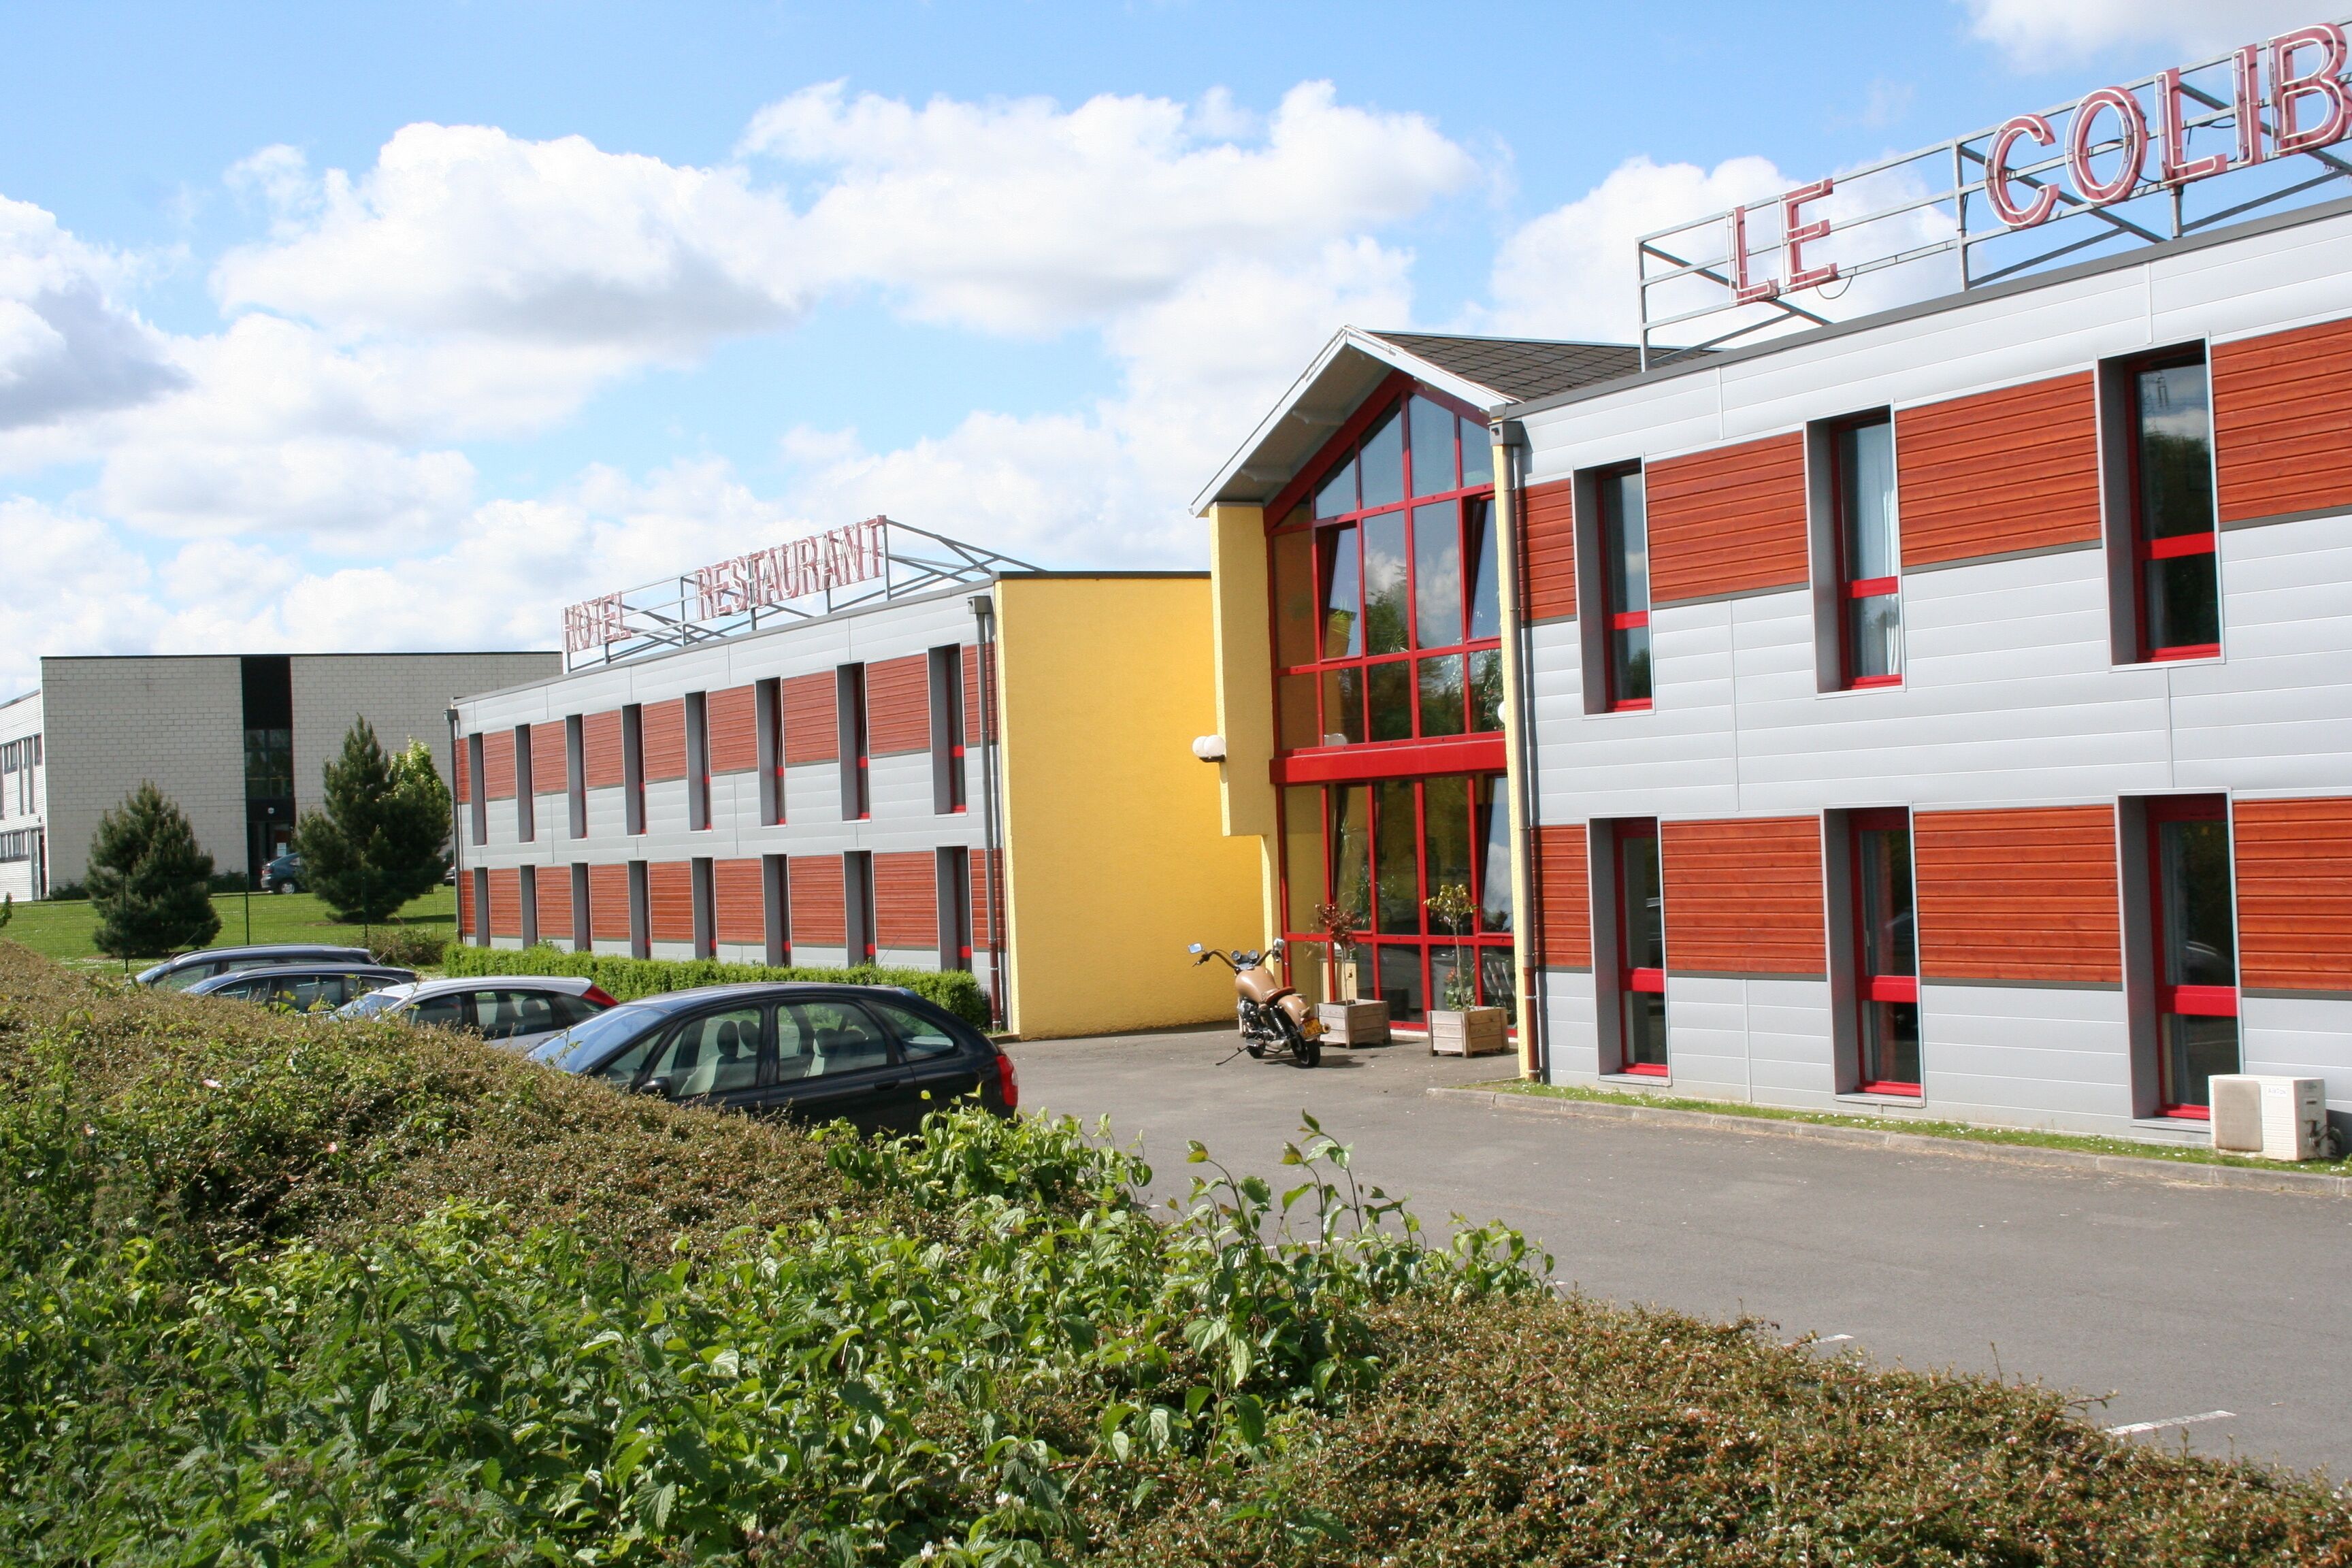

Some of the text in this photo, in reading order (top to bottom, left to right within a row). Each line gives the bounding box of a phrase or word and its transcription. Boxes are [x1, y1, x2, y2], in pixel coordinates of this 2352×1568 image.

[1726, 22, 2352, 306] LE COLIB
[561, 515, 887, 653] HOTEL RESTAURANT
